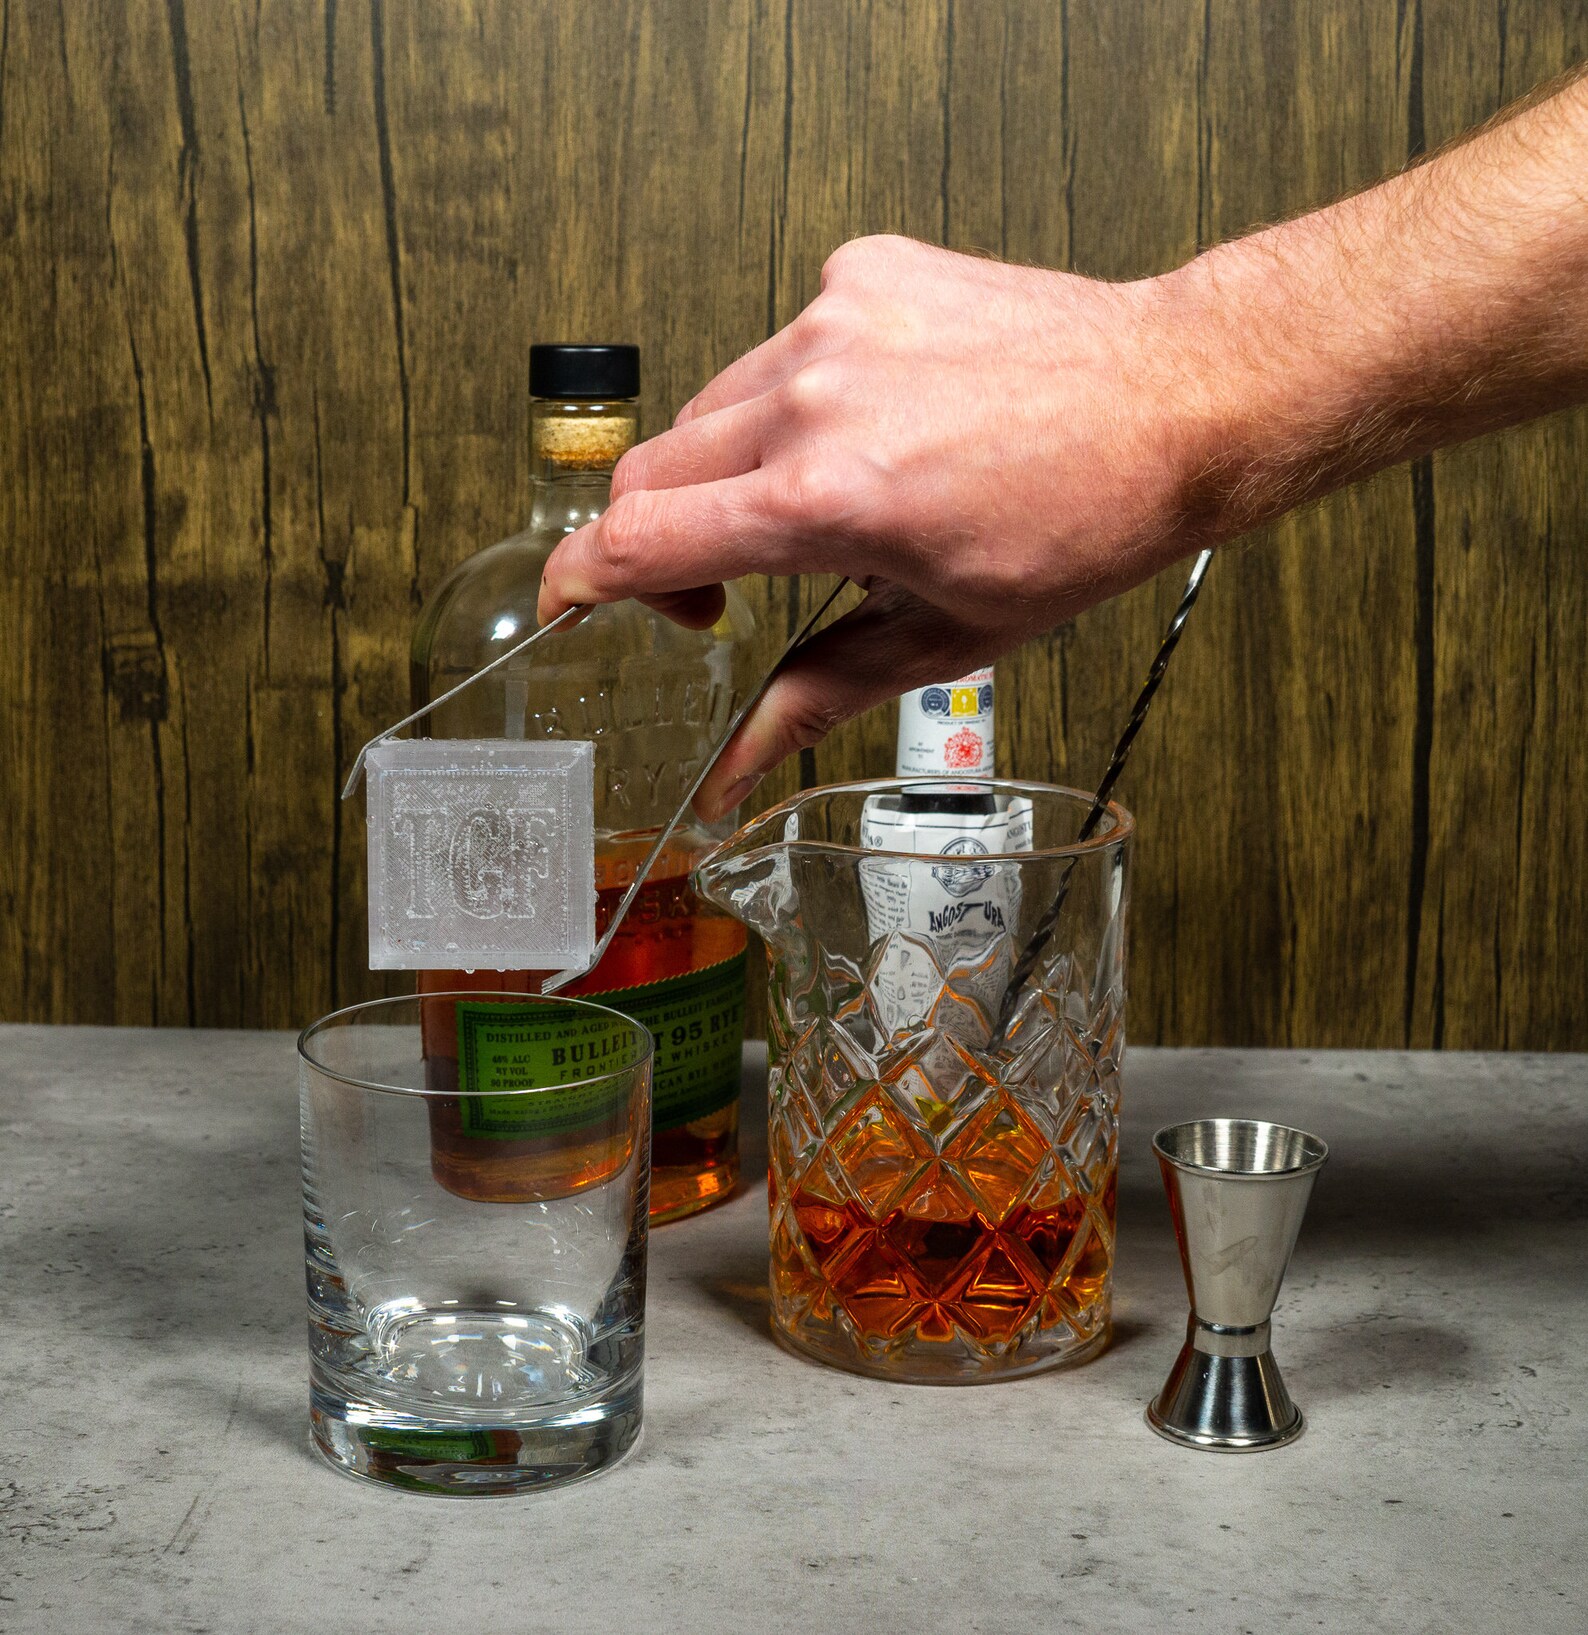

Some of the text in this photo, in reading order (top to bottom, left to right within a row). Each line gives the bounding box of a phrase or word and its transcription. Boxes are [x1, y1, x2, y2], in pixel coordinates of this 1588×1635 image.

[486, 1031, 551, 1043] DISTILLED
[556, 1028, 577, 1039] AND
[582, 1022, 610, 1035] AGED
[552, 1030, 637, 1066] BULLEIT
[671, 1020, 702, 1046] 95
[710, 1004, 738, 1033] RYE
[512, 1055, 531, 1064] ALC
[560, 1050, 637, 1080] FRONTIER
[672, 1030, 735, 1062] WHISKEY
[510, 1067, 528, 1075] VOL
[504, 1079, 535, 1087] PROOF
